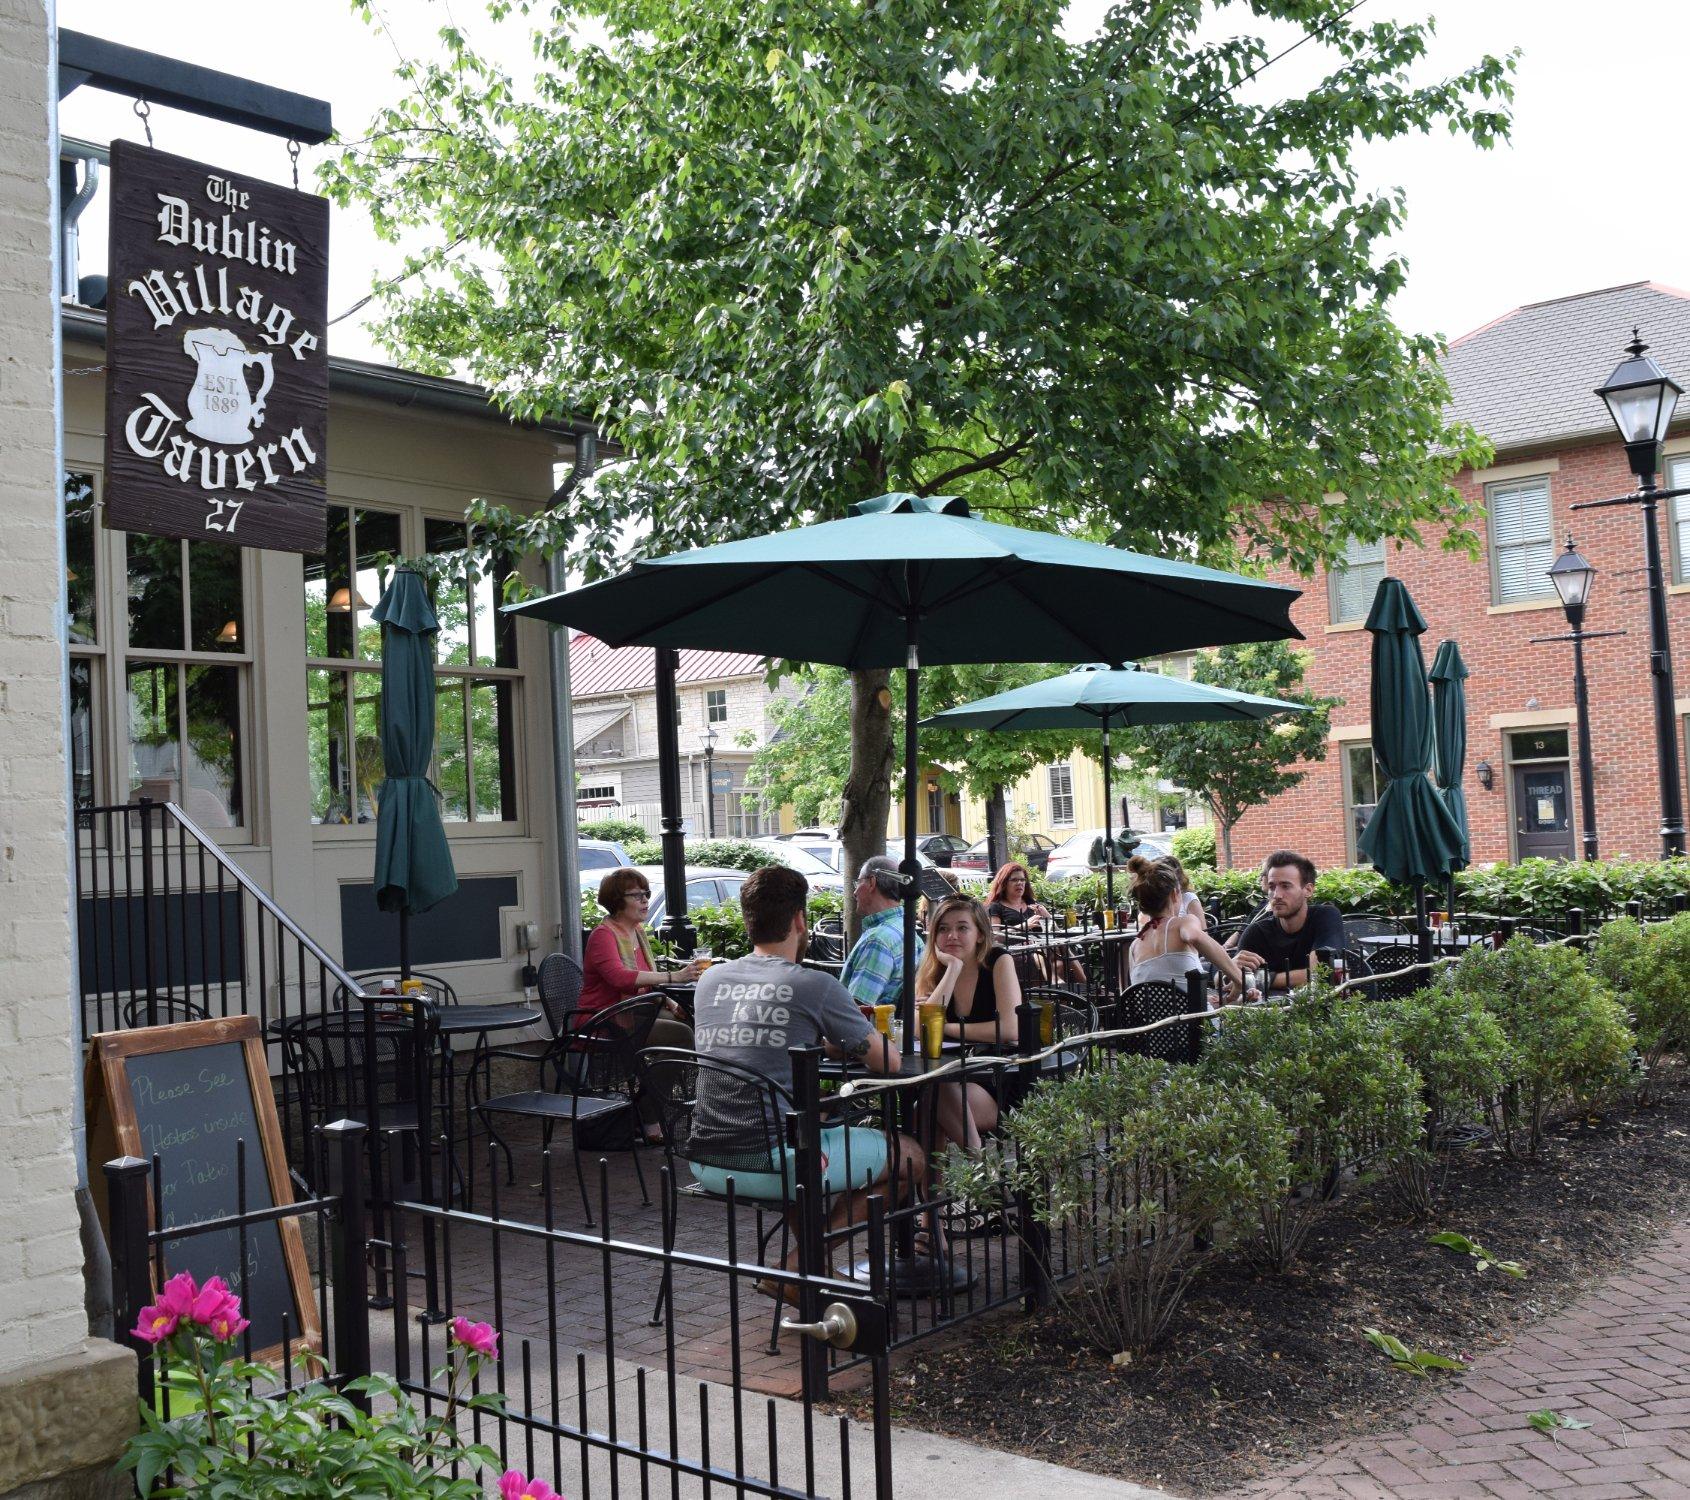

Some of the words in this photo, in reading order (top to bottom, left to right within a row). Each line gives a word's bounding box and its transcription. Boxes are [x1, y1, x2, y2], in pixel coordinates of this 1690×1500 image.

[206, 174, 250, 213] The
[157, 193, 298, 275] Dublin
[128, 264, 319, 360] Village
[203, 373, 240, 397] EST.
[203, 395, 239, 414] 1889
[125, 392, 316, 492] Tavern
[205, 498, 244, 533] 27
[1534, 741, 1545, 750] 13
[1527, 785, 1563, 795] THREAD
[713, 983, 794, 1007] peace
[131, 1075, 195, 1105] Please
[198, 1069, 235, 1094] See
[180, 1158, 229, 1186] Patio
